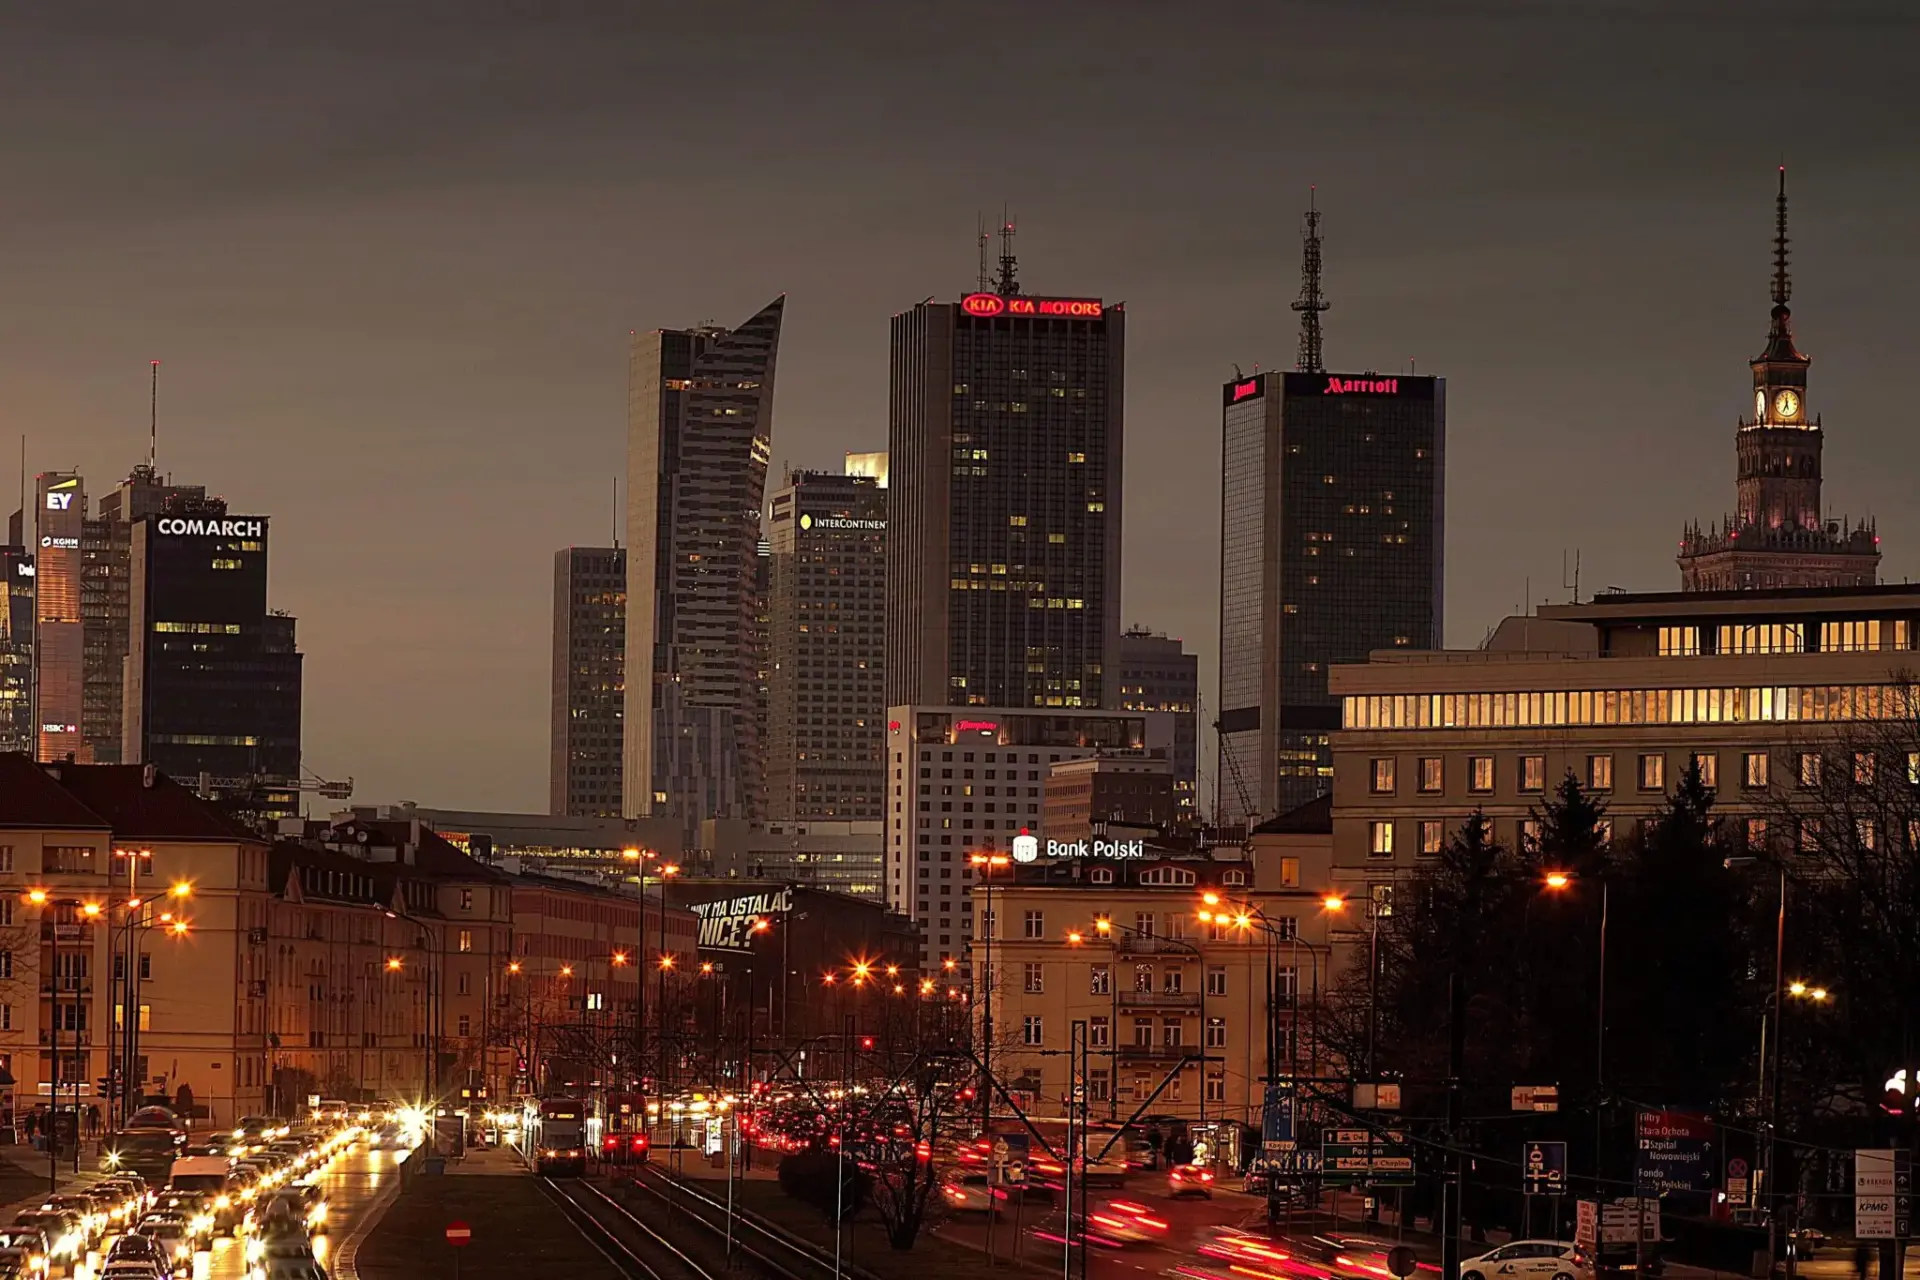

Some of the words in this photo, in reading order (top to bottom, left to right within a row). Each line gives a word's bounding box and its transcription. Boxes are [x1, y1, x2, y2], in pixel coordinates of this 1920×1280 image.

[969, 300, 996, 311] KIA
[1009, 300, 1035, 313] KIA
[1040, 301, 1102, 315] MOTORS
[1324, 377, 1398, 394] Marriott
[47, 493, 72, 510] EY
[158, 518, 261, 537] COMARCH
[53, 537, 78, 546] KGHM
[42, 724, 64, 732] HSBC
[1047, 839, 1089, 856] Bank
[1094, 840, 1143, 858] Polski
[711, 900, 727, 917] MA
[730, 885, 793, 915] USTALAĆ
[1640, 1112, 1660, 1124] Filtry
[1661, 1126, 1689, 1137] Ochota
[1352, 1146, 1383, 1155] Pozań
[1650, 1140, 1677, 1151] Szpital
[1649, 1151, 1700, 1164] Nowowiejski
[1661, 1180, 1691, 1191] Polskiej
[1859, 1203, 1888, 1211] KPMG
